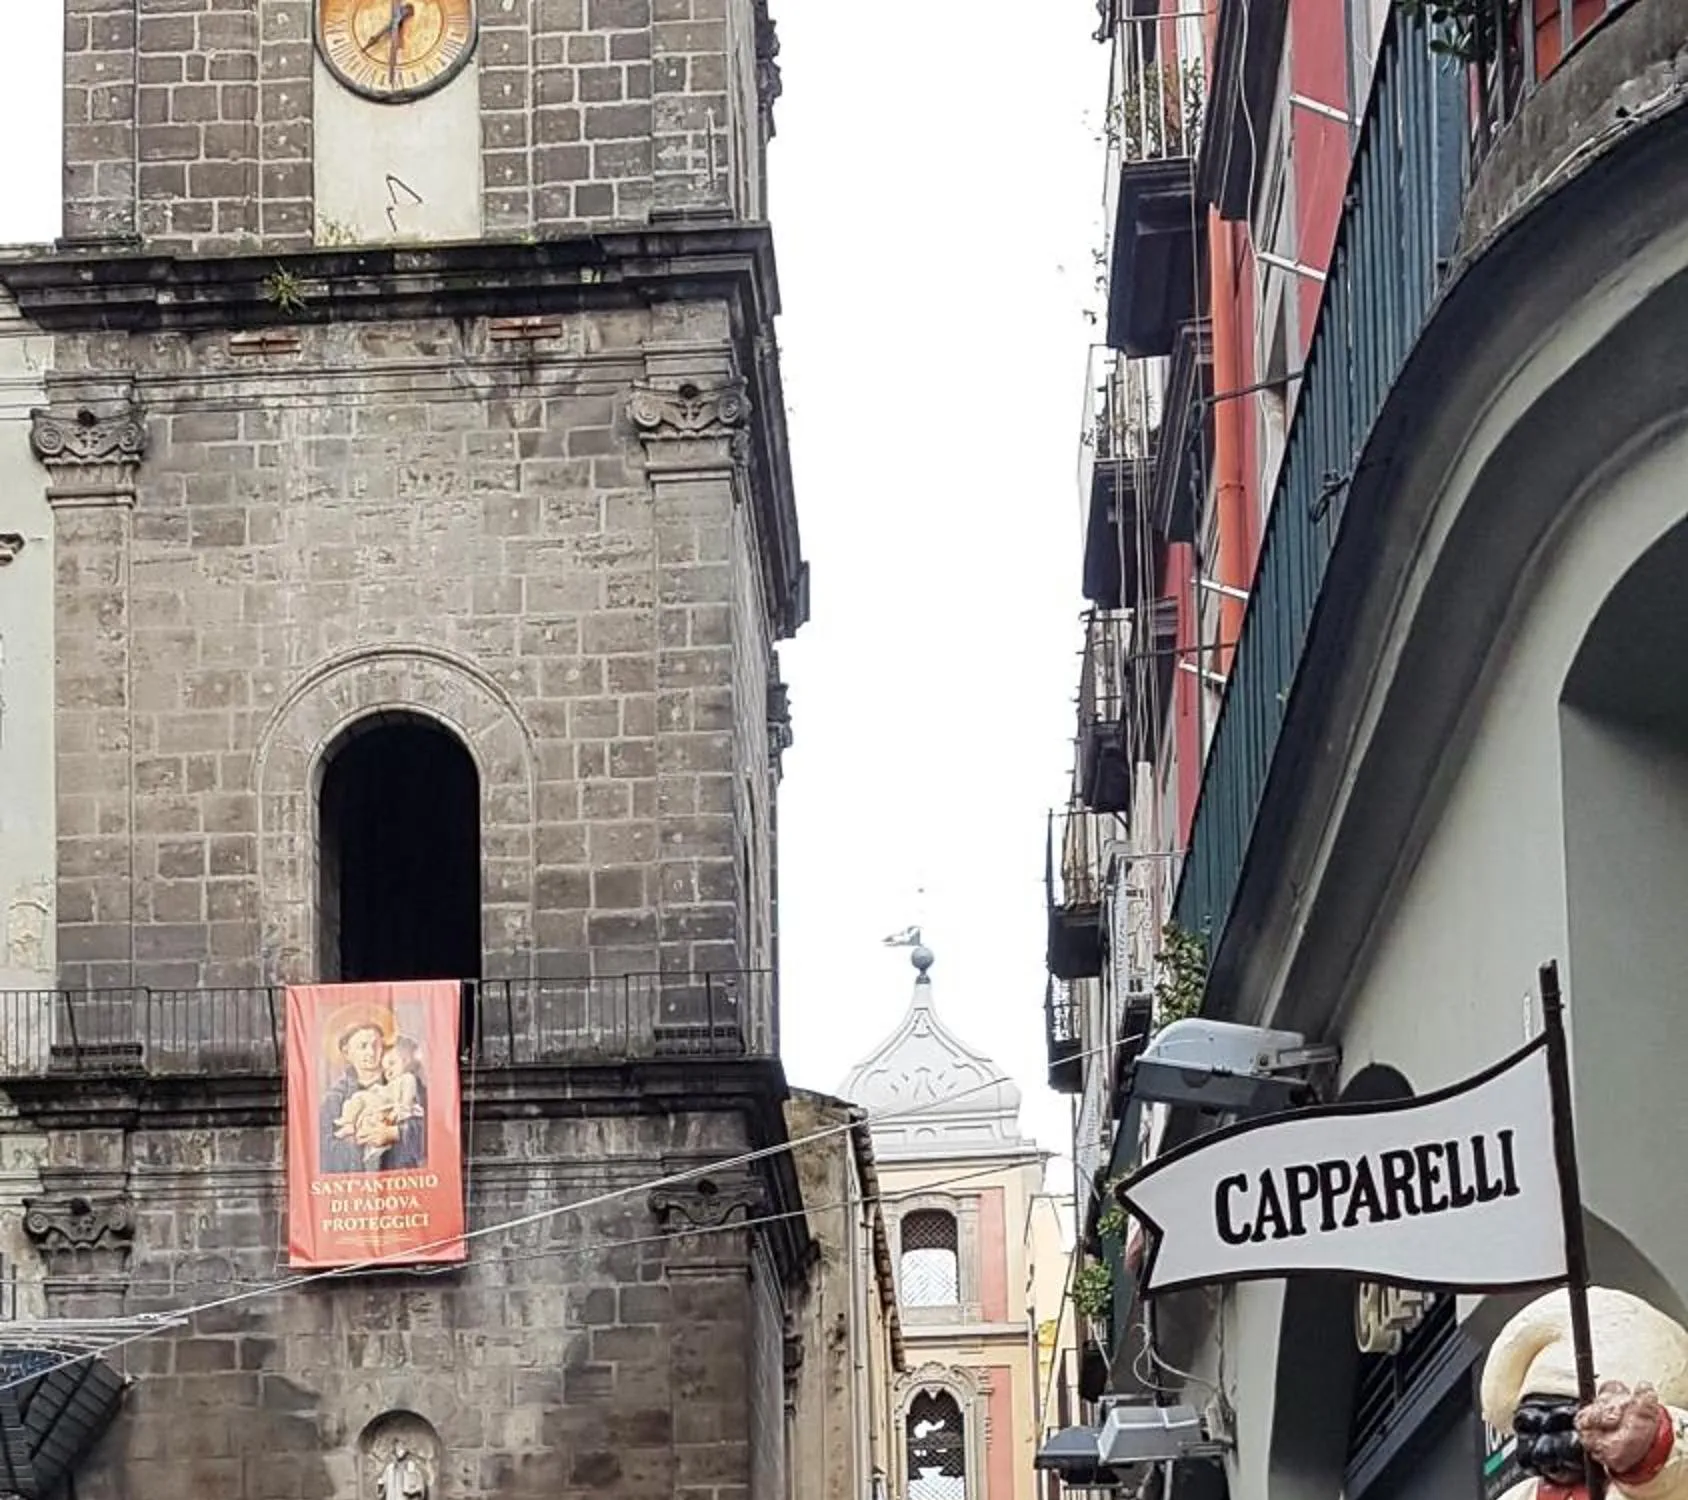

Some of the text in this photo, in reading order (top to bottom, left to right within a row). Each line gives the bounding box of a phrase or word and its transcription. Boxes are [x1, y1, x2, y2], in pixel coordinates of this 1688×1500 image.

[1215, 1130, 1520, 1244] CAPPARELLI
[331, 1195, 419, 1213] DI PADOVA
[321, 1213, 429, 1232] PROTEGGICI
